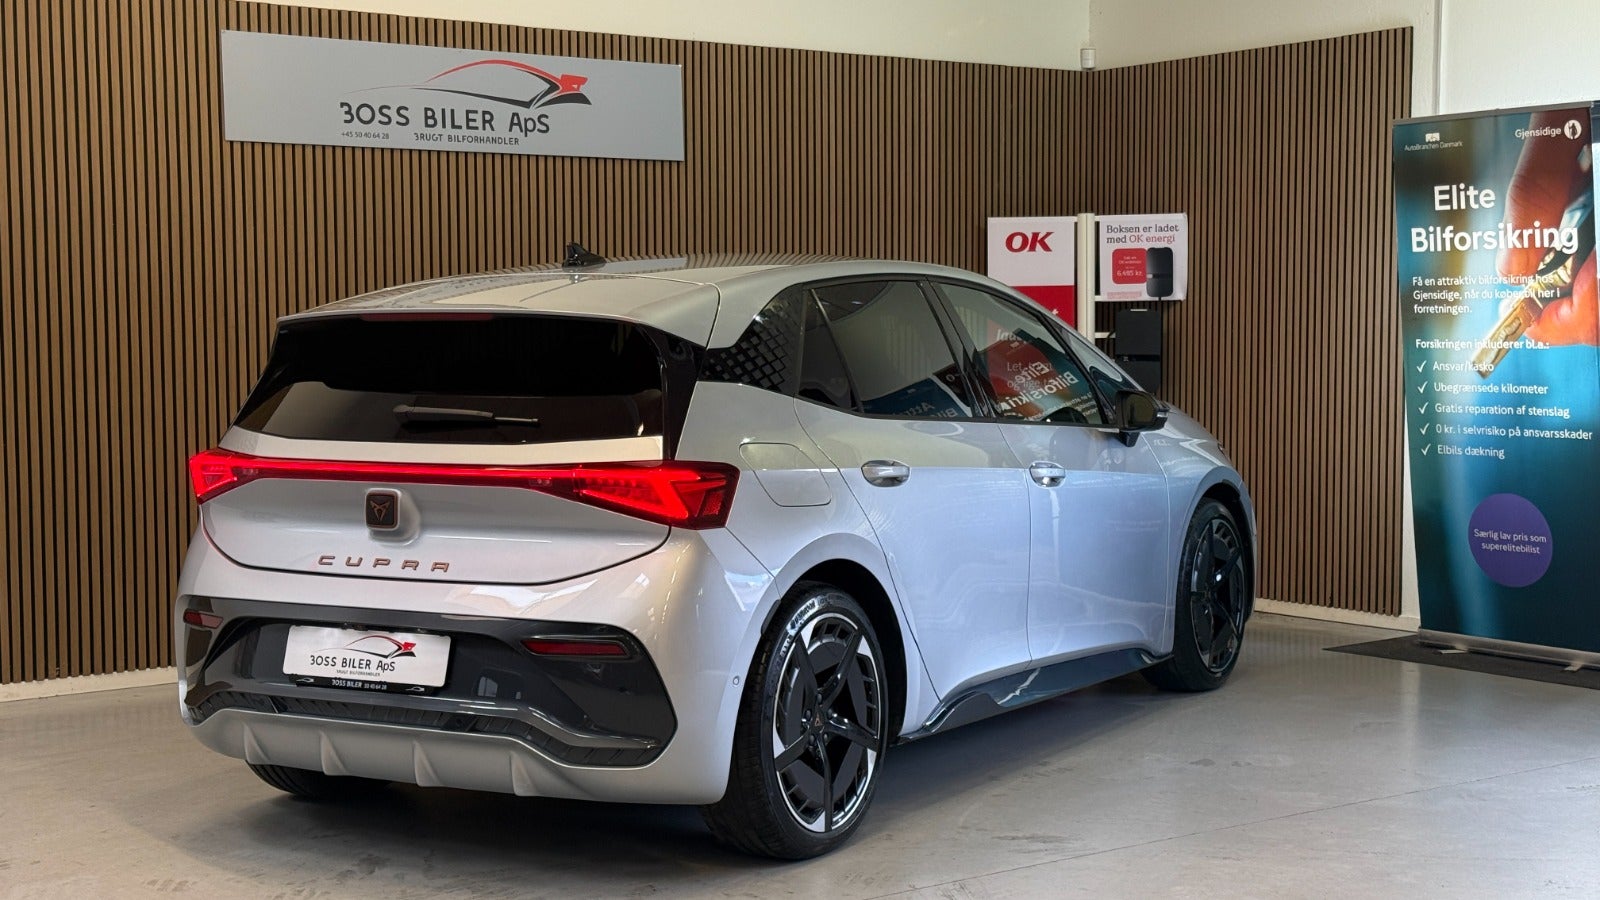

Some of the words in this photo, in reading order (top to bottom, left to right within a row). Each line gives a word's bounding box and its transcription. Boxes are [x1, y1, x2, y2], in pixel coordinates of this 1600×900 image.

[423, 106, 495, 132] BILER
[508, 112, 550, 138] ApS
[447, 134, 520, 146] BILFORHANDLER
[1515, 126, 1562, 140] Gjensidige
[1433, 182, 1496, 211] Elite
[1106, 224, 1140, 234] Boksen
[1142, 225, 1153, 233] er
[1155, 223, 1180, 233] ladet
[1005, 231, 1055, 253] OK
[1106, 234, 1127, 244] med
[1129, 233, 1144, 244] OK
[1146, 232, 1176, 245] energi
[1411, 220, 1579, 255] Bilforsikring
[1412, 276, 1423, 287] Få
[1424, 277, 1436, 286] en
[1437, 275, 1477, 286] attraktiv
[1413, 289, 1463, 301] Gjensidige,
[1464, 288, 1481, 299] når
[1481, 288, 1493, 299] du
[1537, 288, 1556, 299] her
[1413, 304, 1473, 315] forretningen.
[1415, 339, 1473, 351] Forsikringen
[1474, 339, 1524, 349] inkluderer
[1432, 361, 1495, 372] Ansvar/kasko
[1433, 382, 1500, 394] Ubegrænsede
[1501, 383, 1549, 395] kilometer
[1434, 402, 1463, 414] Gratis
[1464, 405, 1514, 416] reparation
[1516, 405, 1526, 415] af
[1527, 406, 1570, 419] stenslag
[1444, 424, 1456, 434] kr.
[1463, 425, 1506, 436] selvrisiko
[1508, 426, 1521, 438] på
[1523, 428, 1593, 440] ansvarsskader
[1437, 444, 1463, 456] Elbils
[1464, 446, 1505, 459] dækning
[1473, 528, 1499, 540] Særlig
[1500, 531, 1511, 540] lav
[1512, 532, 1528, 542] pris
[1529, 534, 1547, 543] som
[1481, 542, 1540, 554] superelitebilist
[318, 555, 450, 573] CUPRA
[341, 658, 372, 671] BILER
[375, 660, 396, 673] ApS
